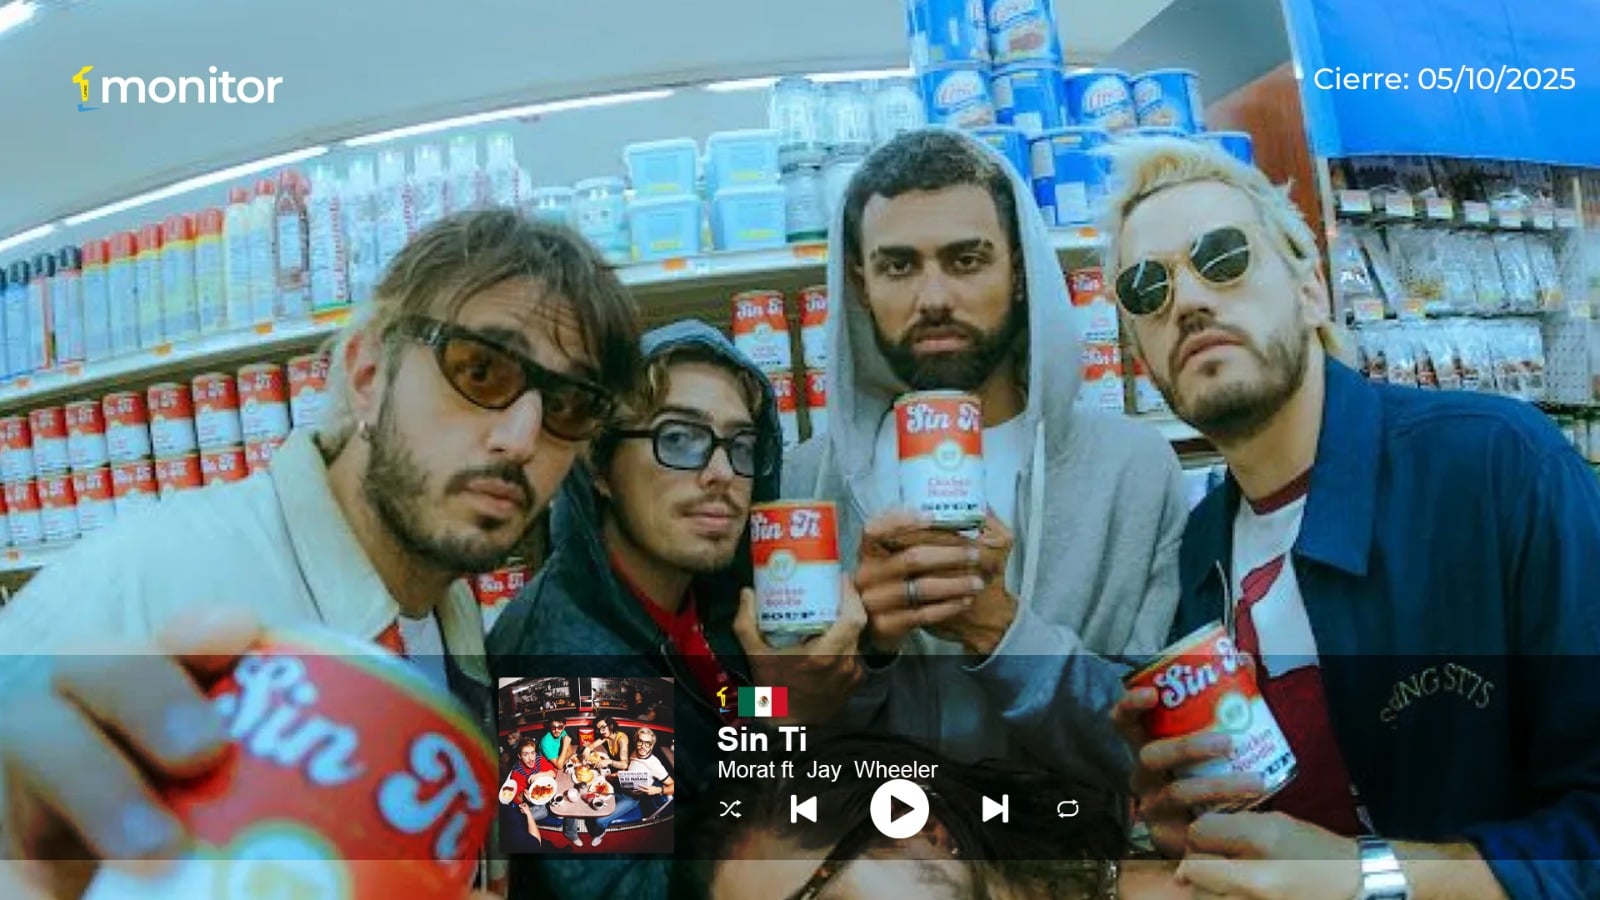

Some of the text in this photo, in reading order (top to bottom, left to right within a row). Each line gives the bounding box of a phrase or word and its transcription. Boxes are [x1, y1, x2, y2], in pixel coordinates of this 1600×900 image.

[906, 403, 950, 433] Sin
[1153, 663, 1222, 709] Sin
[378, 731, 486, 865] Ti
